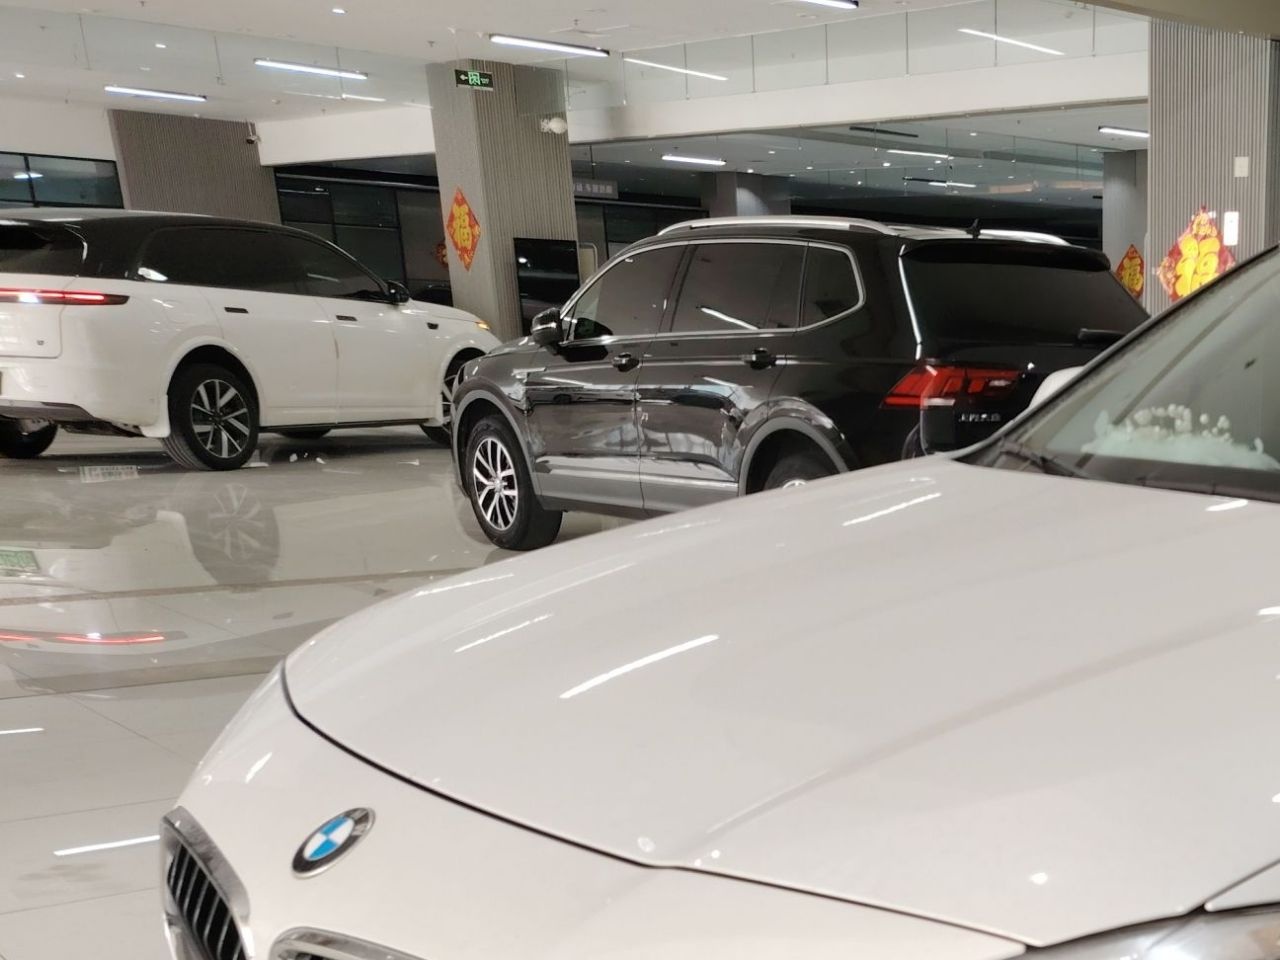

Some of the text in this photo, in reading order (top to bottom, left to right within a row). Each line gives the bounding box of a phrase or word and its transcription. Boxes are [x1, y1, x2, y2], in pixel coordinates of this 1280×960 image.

[453, 203, 472, 249] 福
[1121, 257, 1143, 290] 福
[1175, 235, 1221, 298] 福
